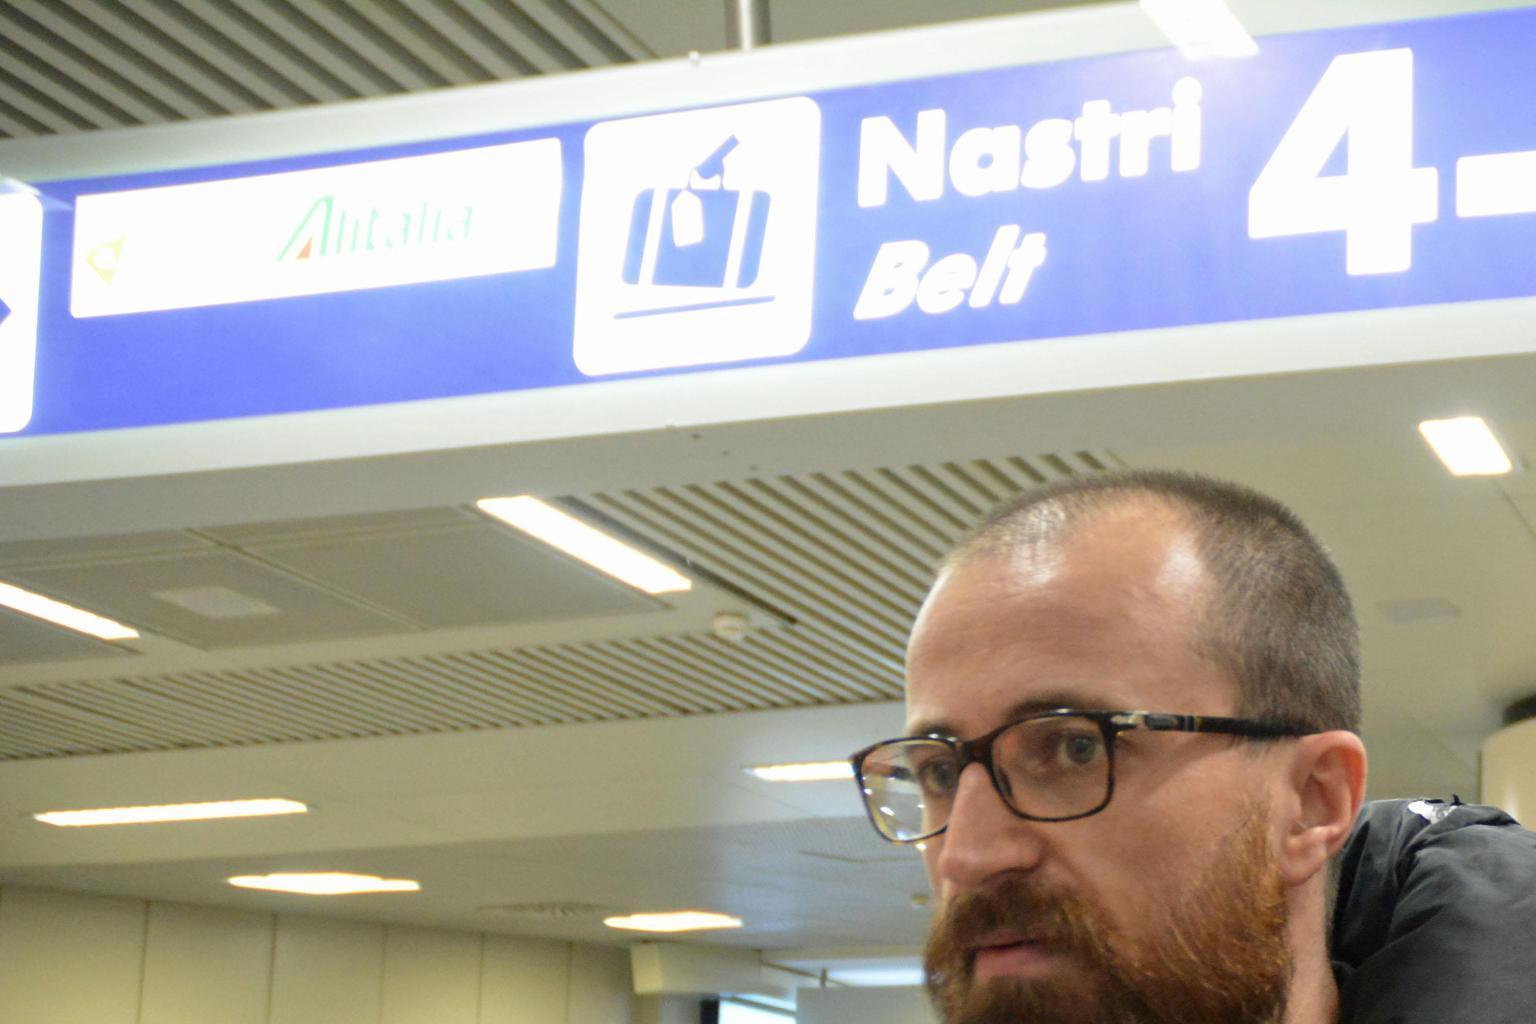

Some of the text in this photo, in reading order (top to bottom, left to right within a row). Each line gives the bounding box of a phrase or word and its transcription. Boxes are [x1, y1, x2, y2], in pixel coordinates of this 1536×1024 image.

[857, 76, 1202, 208] Nastri
[275, 194, 474, 263] Alitalia
[853, 225, 1047, 321] Belt
